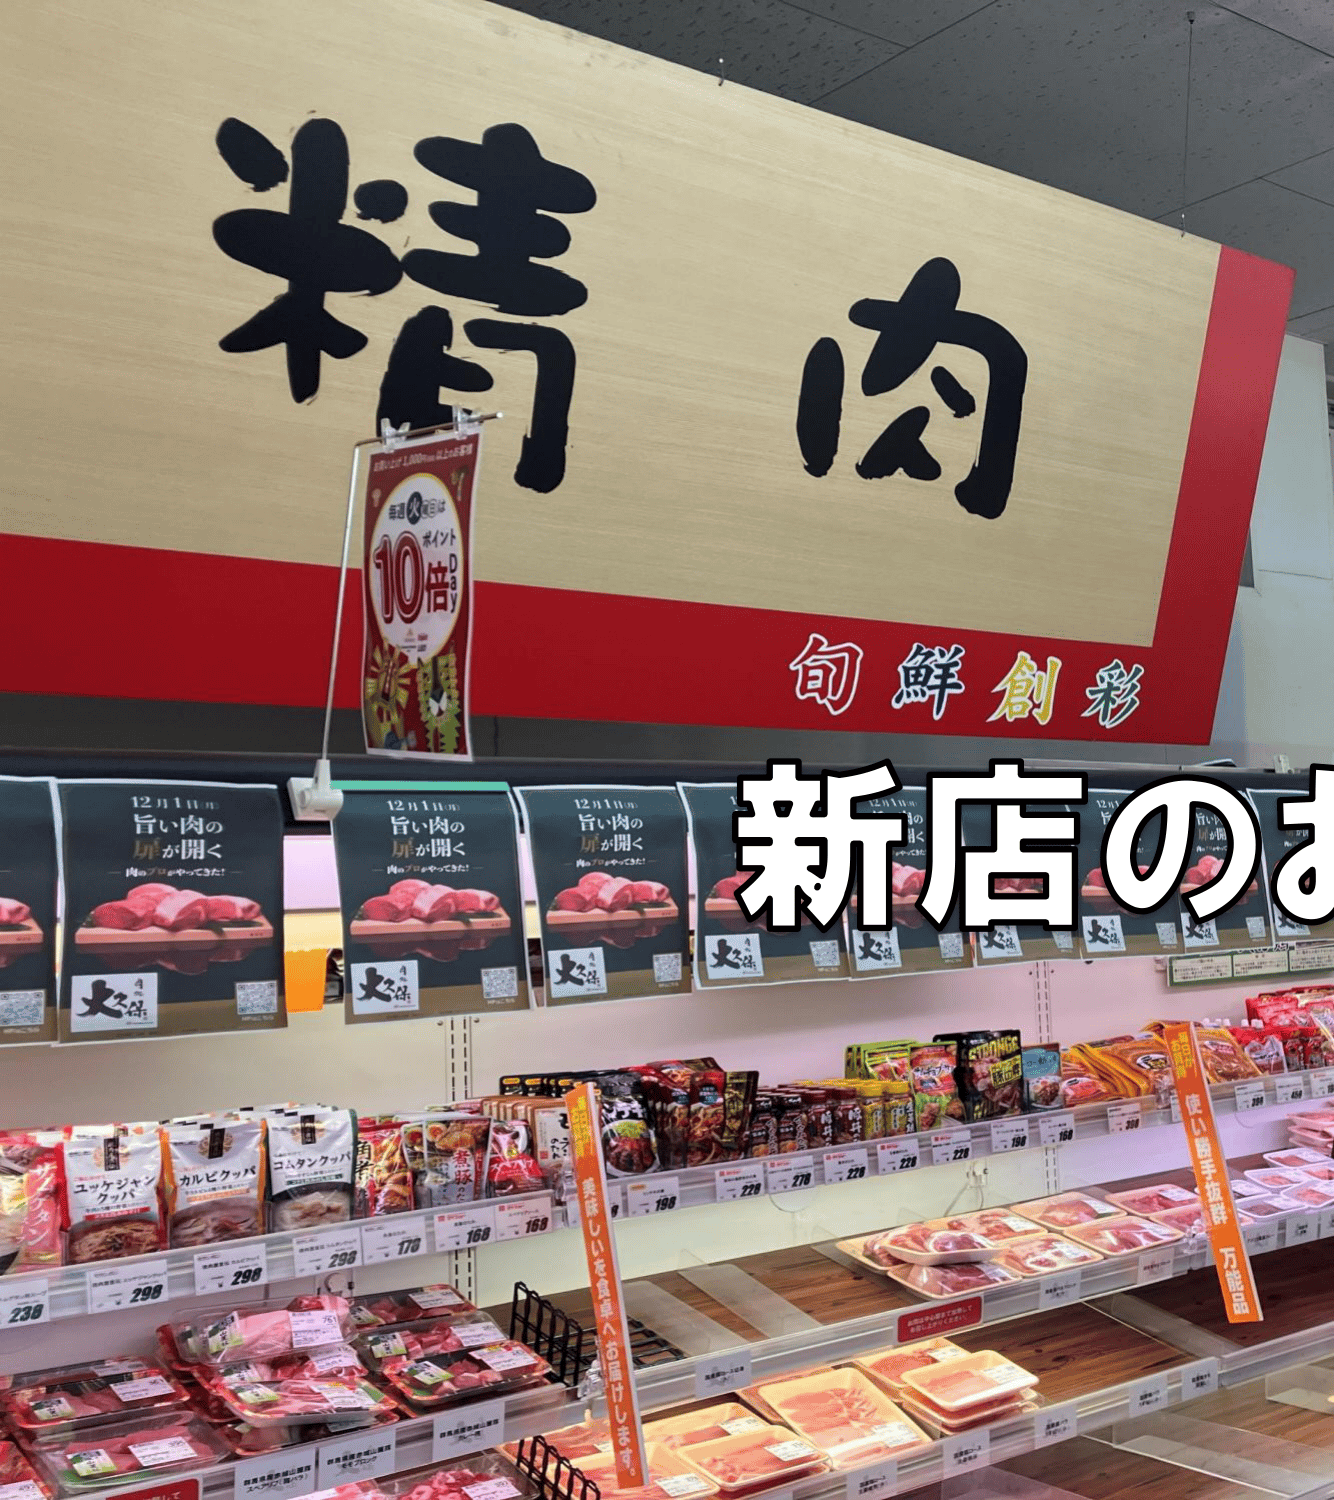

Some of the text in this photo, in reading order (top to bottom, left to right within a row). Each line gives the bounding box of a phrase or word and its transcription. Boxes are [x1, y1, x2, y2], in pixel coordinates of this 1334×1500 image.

[422, 528, 456, 548] ポイント
[790, 633, 1144, 729] 旬鮮創彩
[134, 814, 223, 835] 旨い肉の
[390, 815, 465, 835] 旨い肉の
[579, 813, 643, 831] 旨い肉の
[133, 839, 223, 860] 扉が開く
[392, 838, 466, 858] 扉が開く
[580, 833, 643, 853] 扉が開く
[273, 1152, 352, 1171] コムタンクッパ
[899, 1156, 917, 1169] 228
[953, 1148, 969, 1159] 228
[180, 1165, 256, 1187] カルビクッパ
[792, 1173, 811, 1186] 278
[847, 1167, 865, 1179] 228
[73, 1175, 155, 1194] ユッケジャン
[742, 1183, 761, 1195] 228
[97, 1189, 135, 1204] クッパ
[656, 1196, 677, 1211] 198
[525, 1217, 548, 1233] 168
[466, 1226, 490, 1244] 168
[329, 1250, 357, 1268] 298
[231, 1267, 262, 1286] 298
[1219, 1247, 1250, 1315] 万能品
[130, 1284, 163, 1303] 298
[8, 1303, 43, 1323] 238
